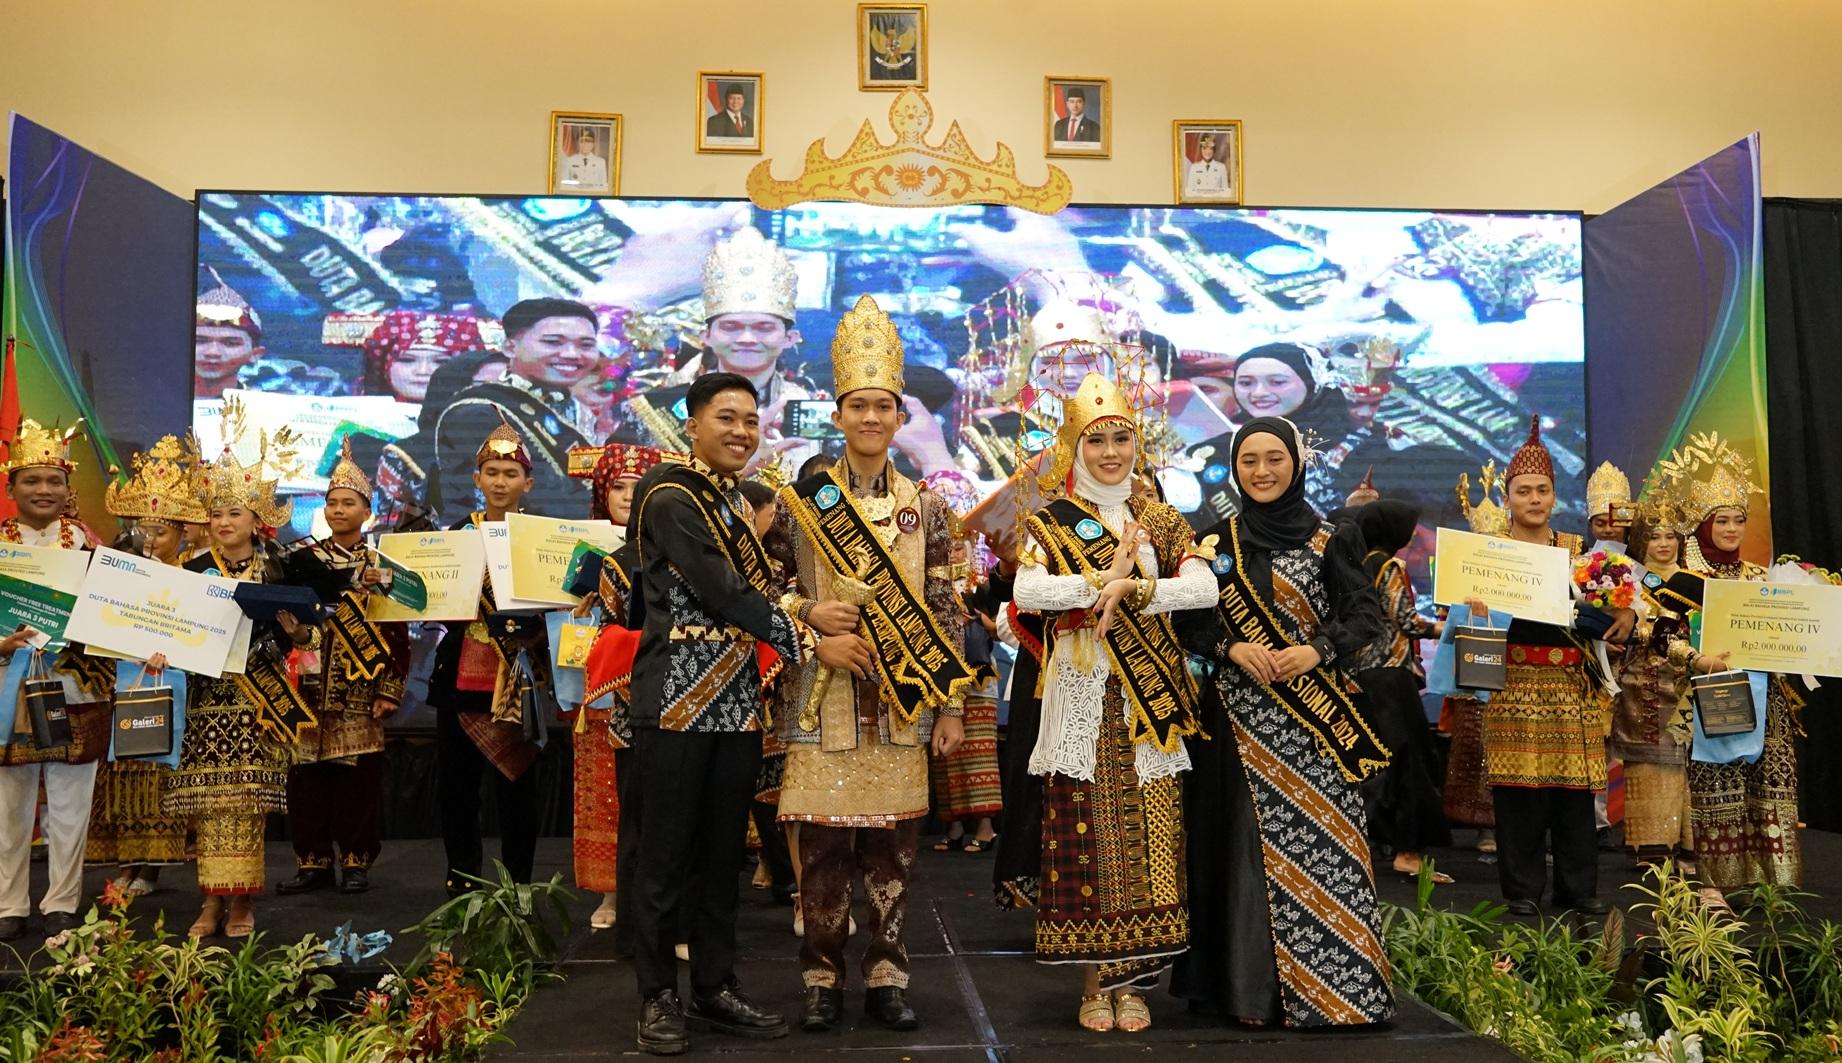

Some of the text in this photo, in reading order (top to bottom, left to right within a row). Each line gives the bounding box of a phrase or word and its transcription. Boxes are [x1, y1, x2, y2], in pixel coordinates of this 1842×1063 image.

[1210, 489, 1239, 519] DUT
[900, 511, 917, 526] 09
[538, 553, 570, 566] PEME
[737, 533, 758, 576] DUTA
[1462, 564, 1528, 585] PEMENANG
[1532, 576, 1543, 586] IV
[1, 590, 28, 604] VOUCHER
[42, 602, 72, 617] TREATMEN
[827, 511, 858, 546] DUTA
[896, 606, 932, 655] LAMPUNG
[920, 645, 949, 673] 2025
[88, 593, 227, 635] DUTA BAHASA PROVINSI LAMPUNG 2025
[146, 600, 171, 610] JUARA
[8, 607, 31, 620] JUARA
[32, 613, 39, 622] 3
[39, 616, 59, 629] PUTRI
[119, 610, 192, 634] TABUNGAN BRITAMA
[1730, 618, 1821, 634] PEMENANG IV
[1220, 582, 1250, 625] DUTA
[1330, 713, 1359, 751] 2024
[1125, 648, 1165, 698] LAMPUNG
[1148, 691, 1178, 720] 2025
